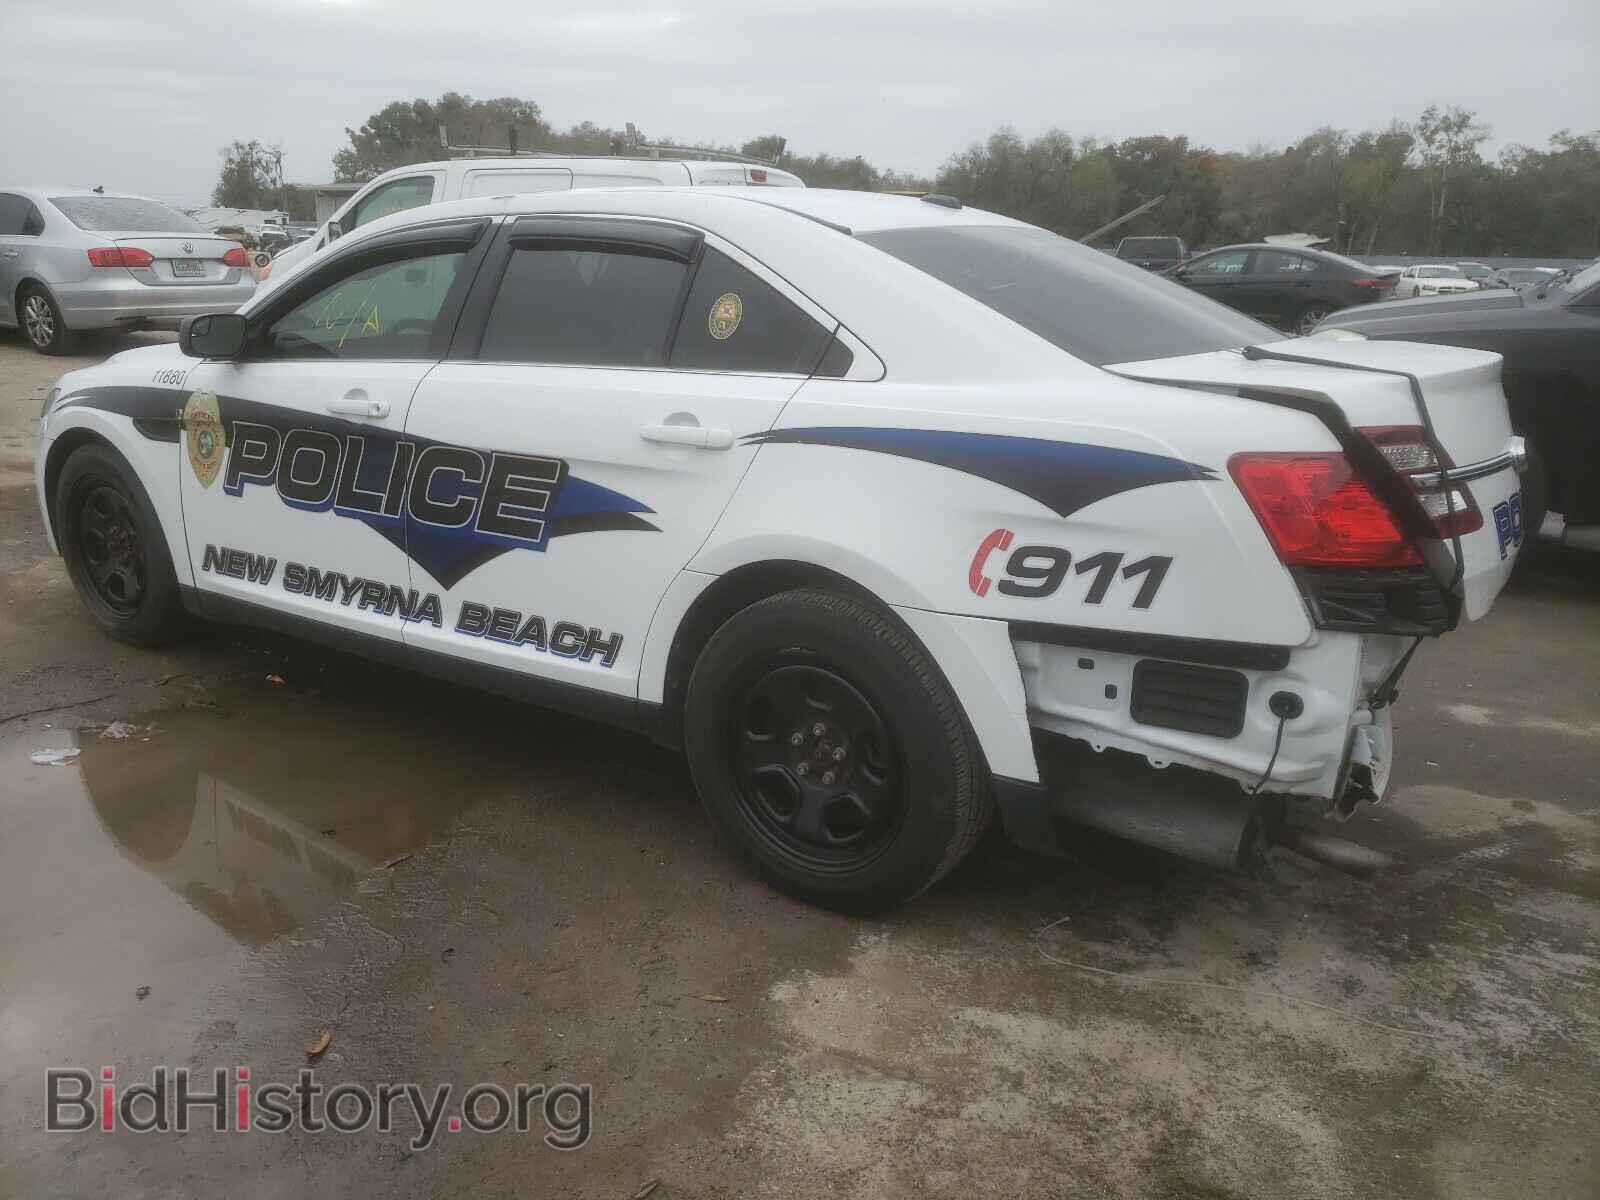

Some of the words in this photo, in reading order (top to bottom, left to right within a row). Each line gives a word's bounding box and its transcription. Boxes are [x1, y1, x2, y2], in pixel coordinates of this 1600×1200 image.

[223, 421, 567, 551] POLICE
[202, 544, 277, 585] NEW
[283, 561, 442, 628] SMYRNA
[455, 600, 624, 668] BEACH
[996, 546, 1173, 609] 911
